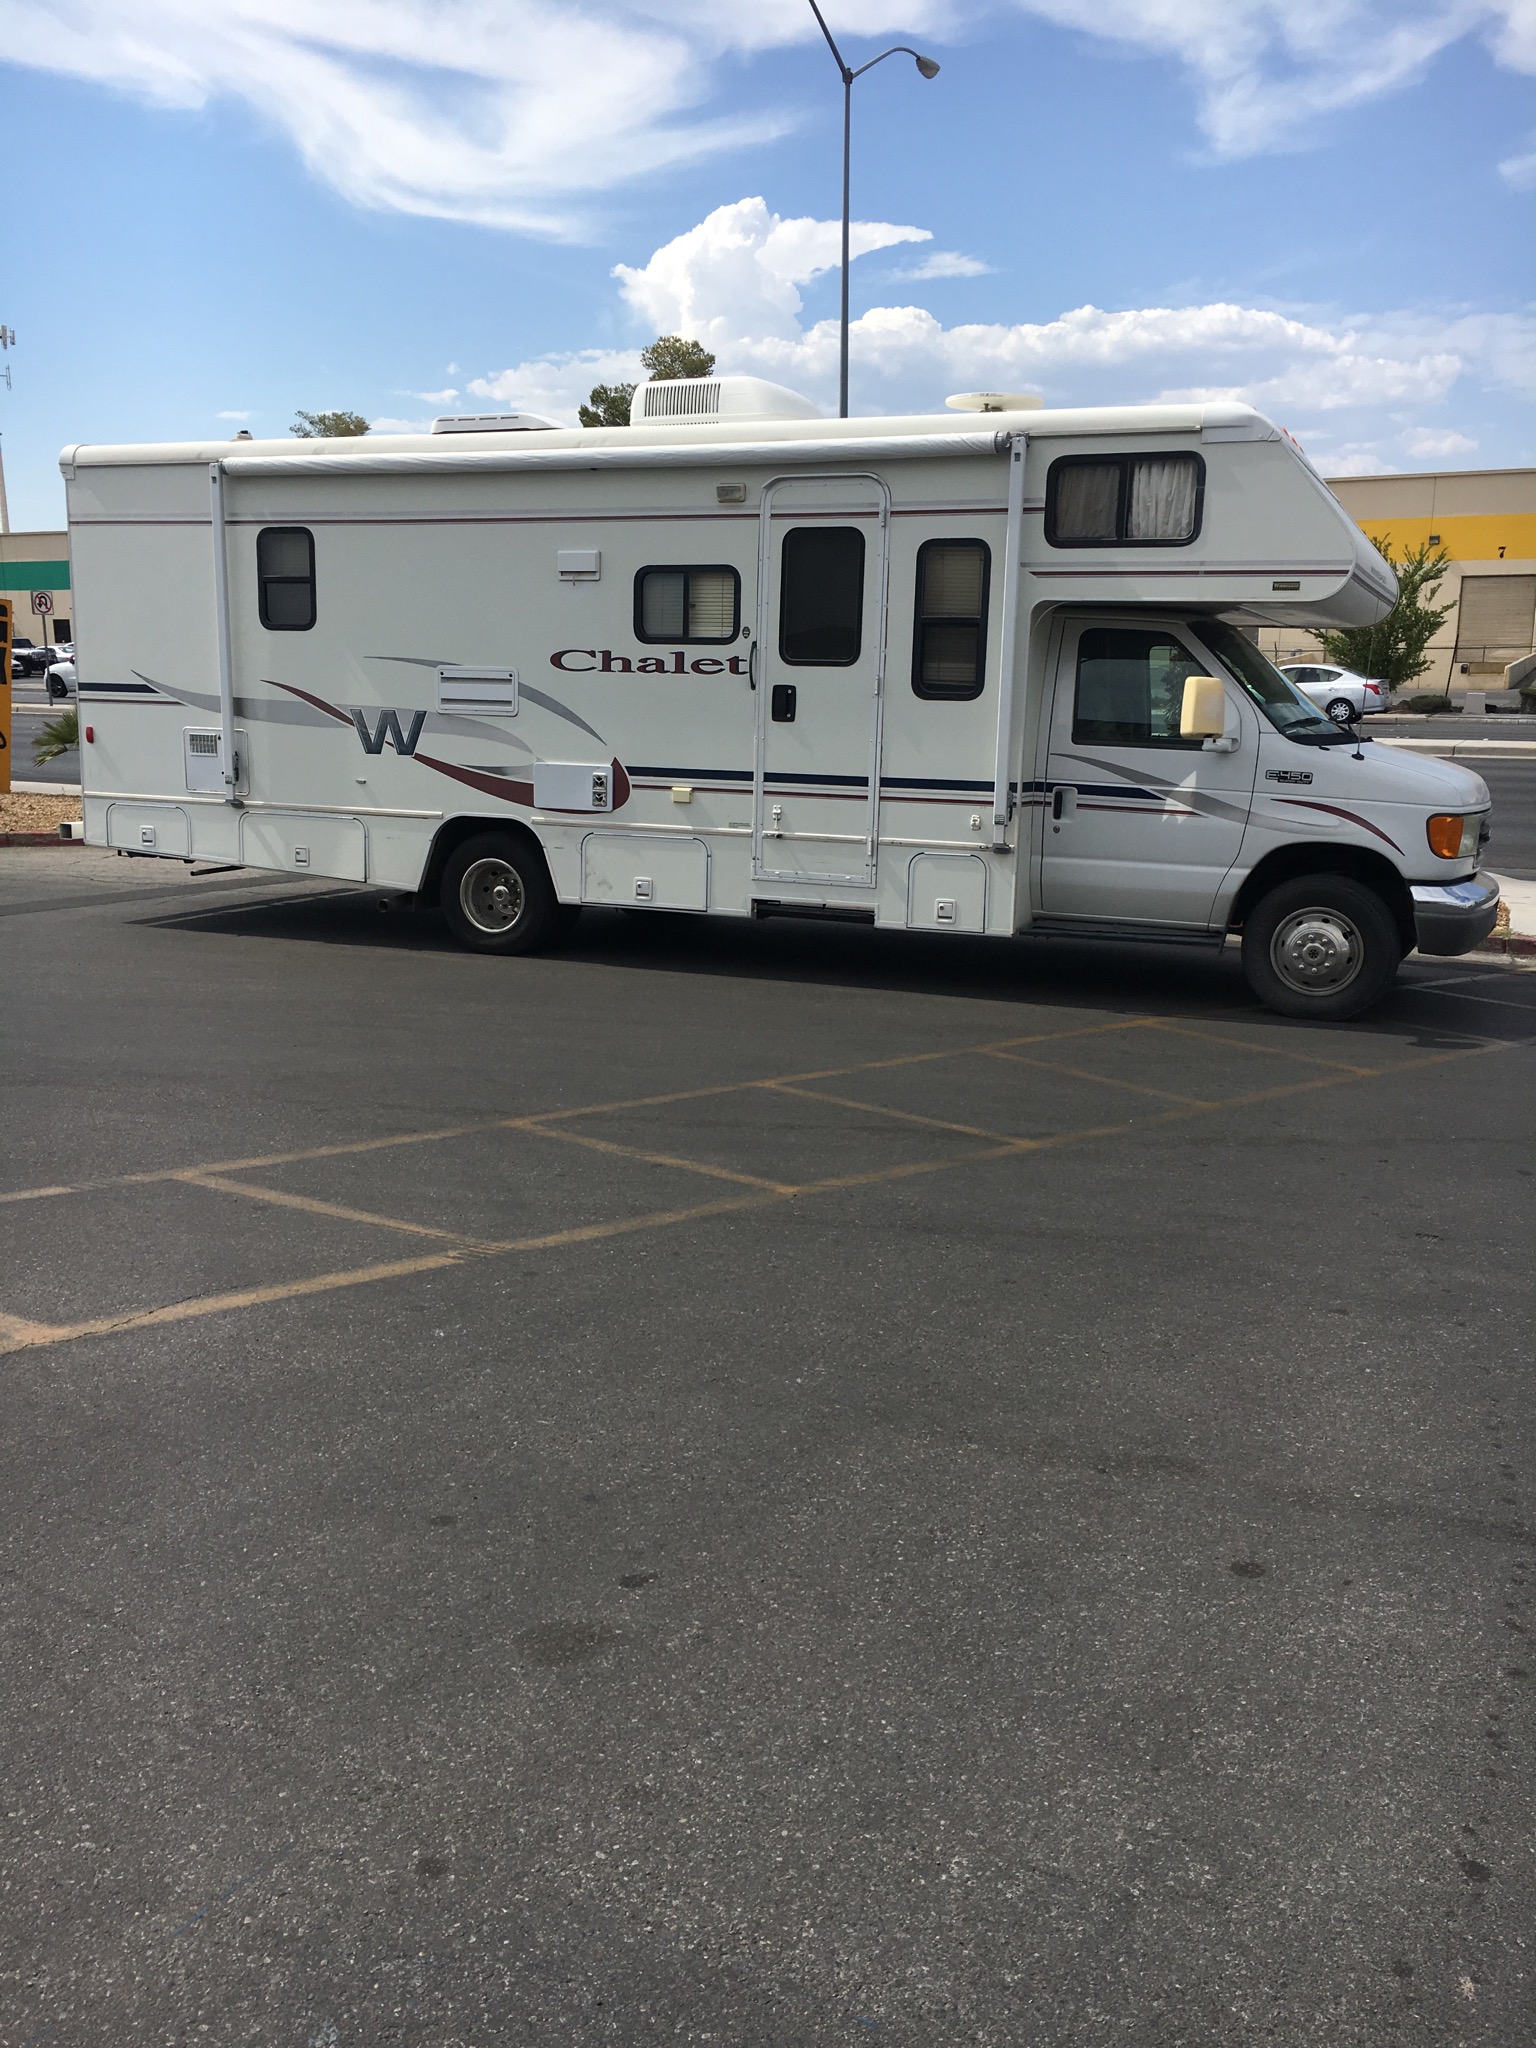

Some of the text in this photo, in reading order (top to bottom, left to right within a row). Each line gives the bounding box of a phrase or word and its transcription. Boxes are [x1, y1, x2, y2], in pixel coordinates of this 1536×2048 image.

[1498, 546, 1506, 558] 7
[550, 649, 749, 675] Chalet
[349, 708, 428, 756] W
